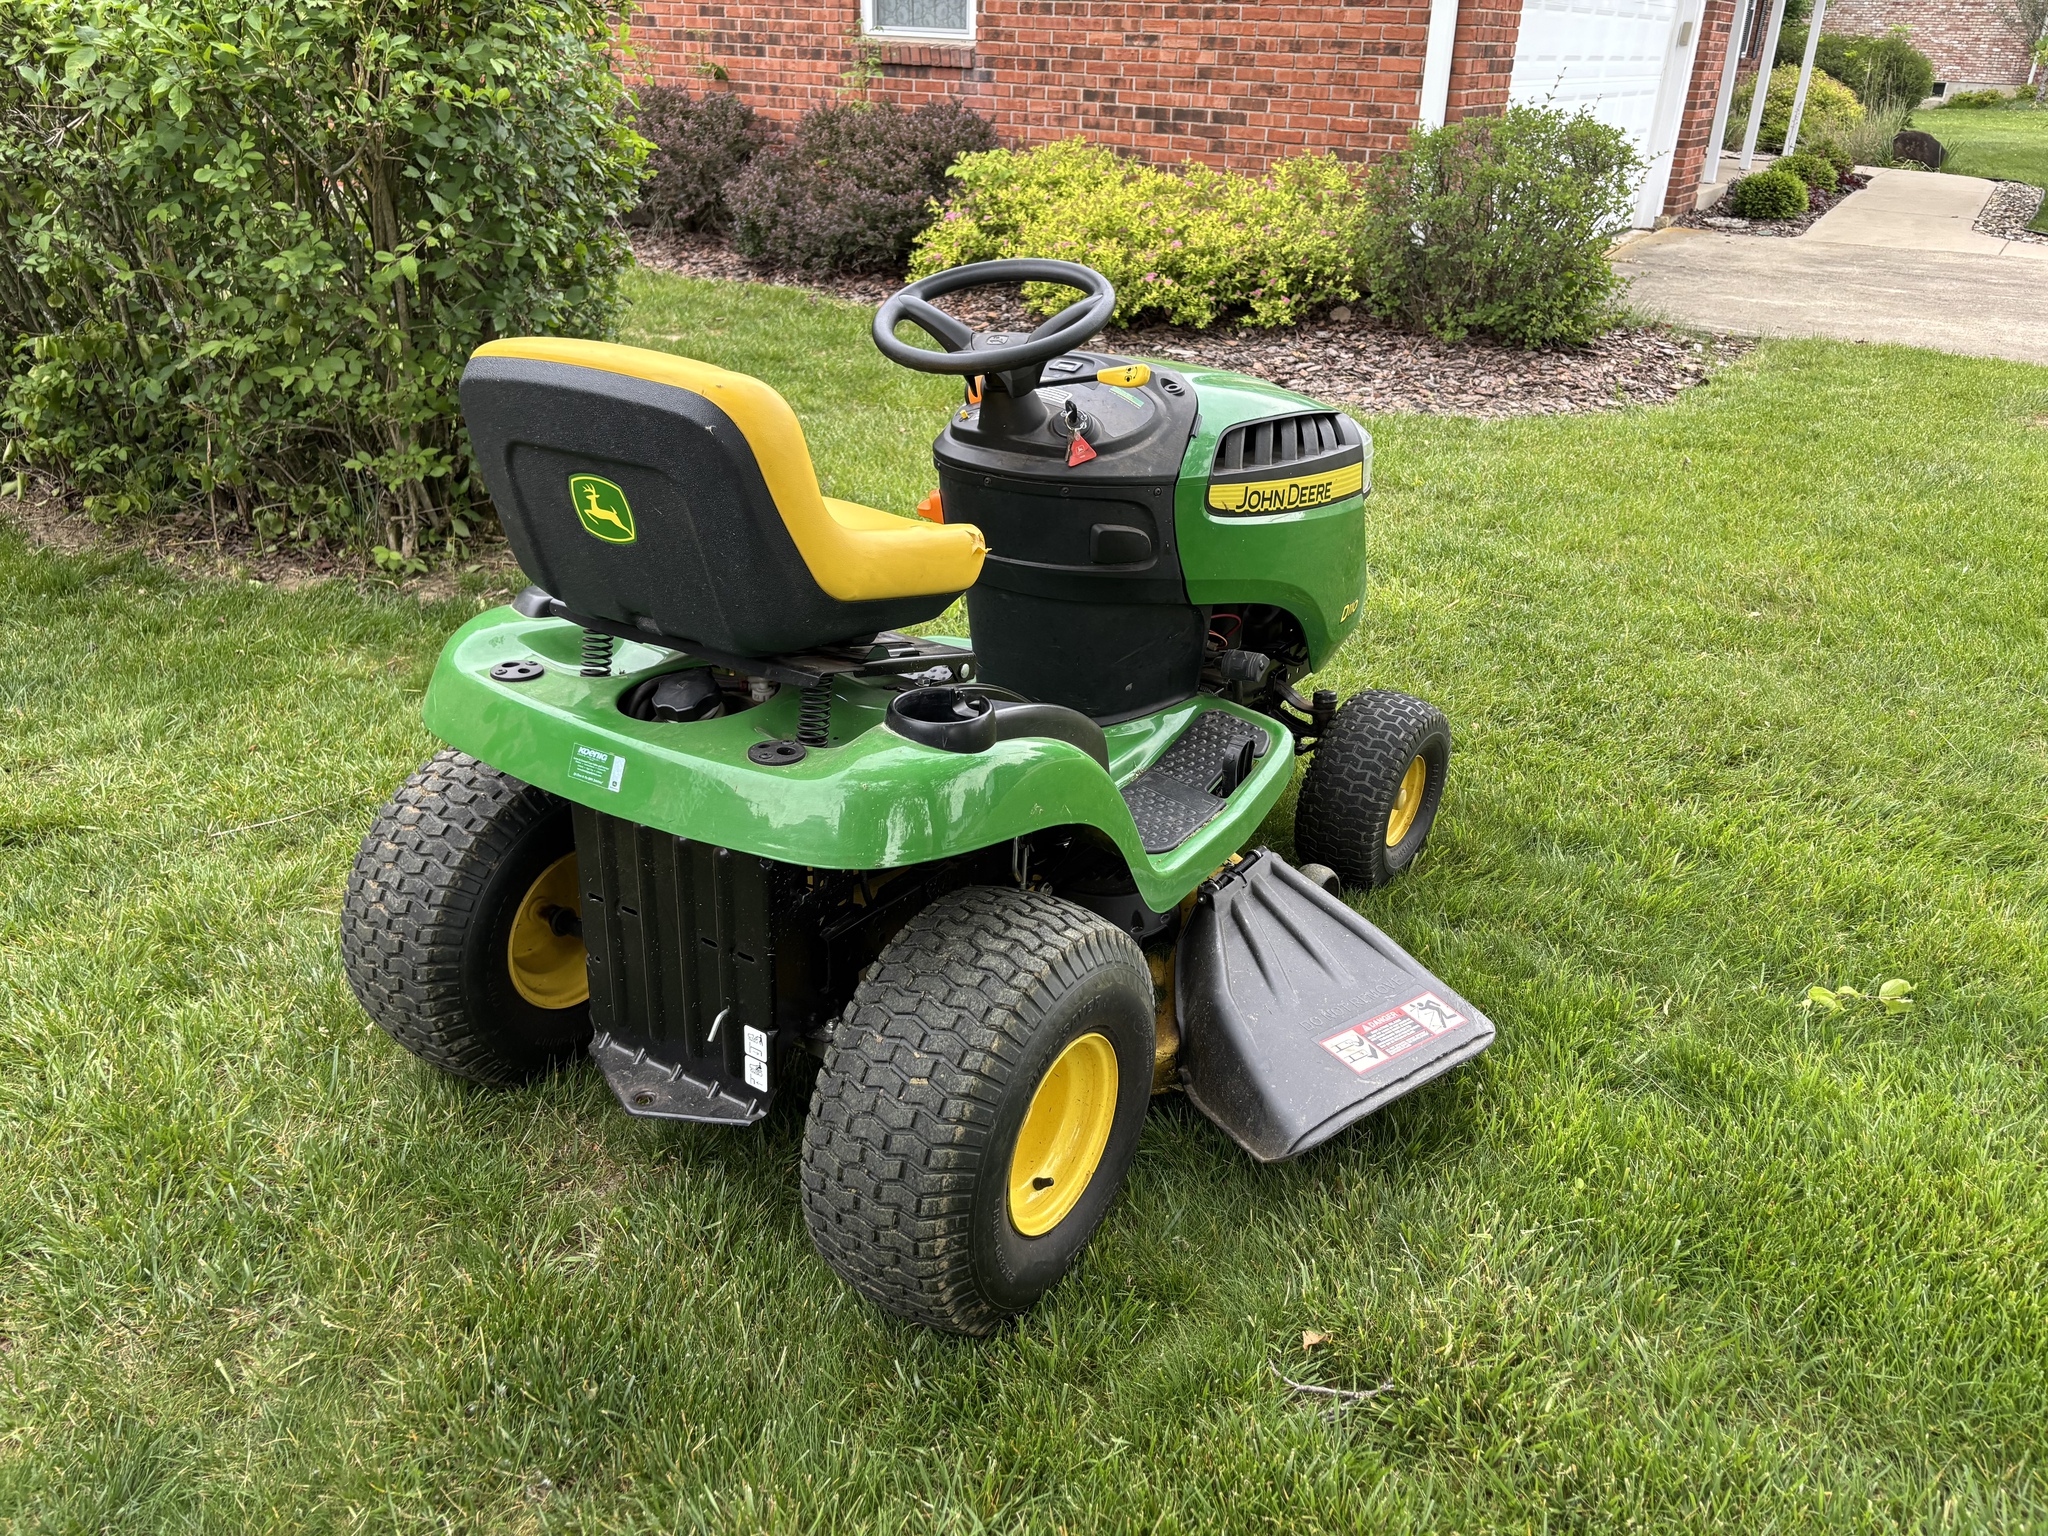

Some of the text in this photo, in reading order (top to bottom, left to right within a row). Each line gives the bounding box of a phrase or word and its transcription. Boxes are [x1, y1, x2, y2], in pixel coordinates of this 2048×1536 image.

[1235, 481, 1333, 510] JOHN DEERE
[1369, 1011, 1398, 1028] DANGER
